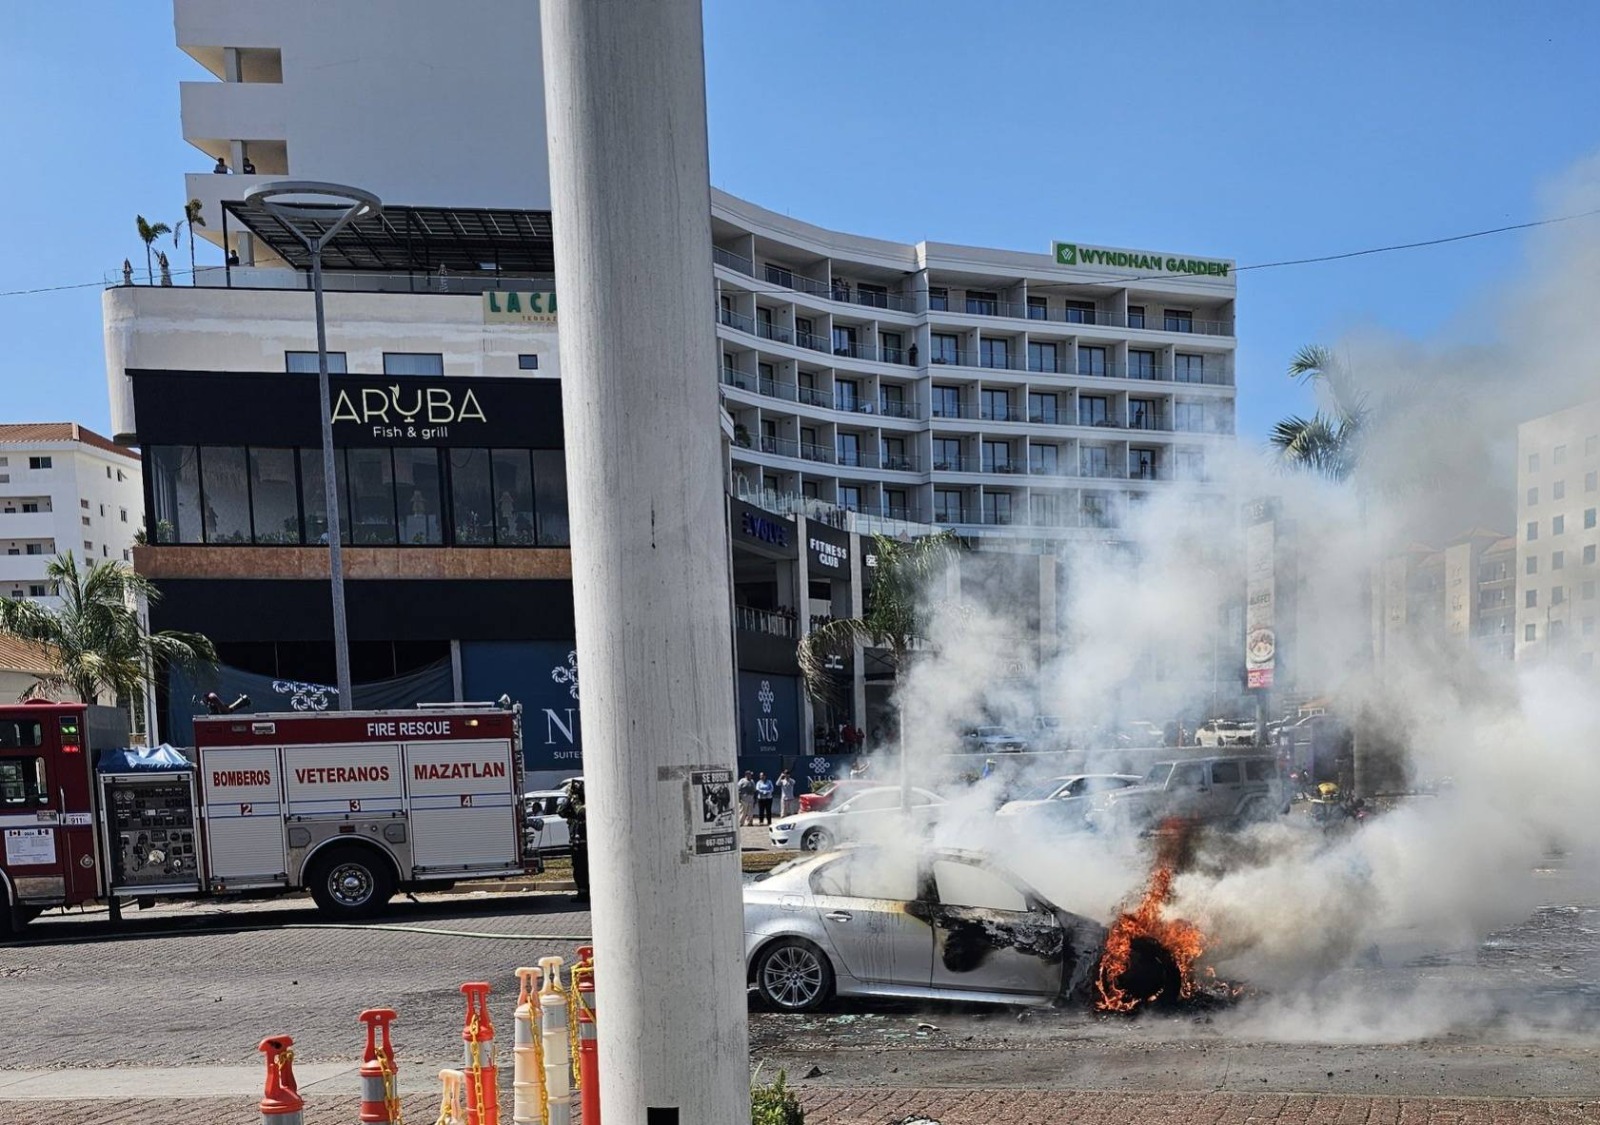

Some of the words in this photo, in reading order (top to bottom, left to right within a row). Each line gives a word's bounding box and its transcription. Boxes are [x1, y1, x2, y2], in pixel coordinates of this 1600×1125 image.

[1079, 249, 1162, 271] WYNDHAM
[1166, 258, 1228, 277] GARDEN
[489, 289, 521, 313] LA
[331, 385, 487, 424] ARUBA
[373, 426, 402, 438] Fish
[407, 426, 417, 438] &
[422, 426, 448, 440] grill
[810, 538, 847, 560] FITNESS
[819, 552, 839, 568] CLUB
[367, 722, 396, 737] FIRE
[399, 721, 450, 736] RESCUE
[542, 708, 579, 744] N
[757, 718, 779, 742] NUS
[213, 770, 271, 787] BOMBEROS
[295, 766, 390, 784] VETERANOS
[414, 762, 505, 780] MAZATLAN
[242, 804, 252, 815] 2
[351, 800, 360, 811] 3
[463, 796, 471, 807] 4
